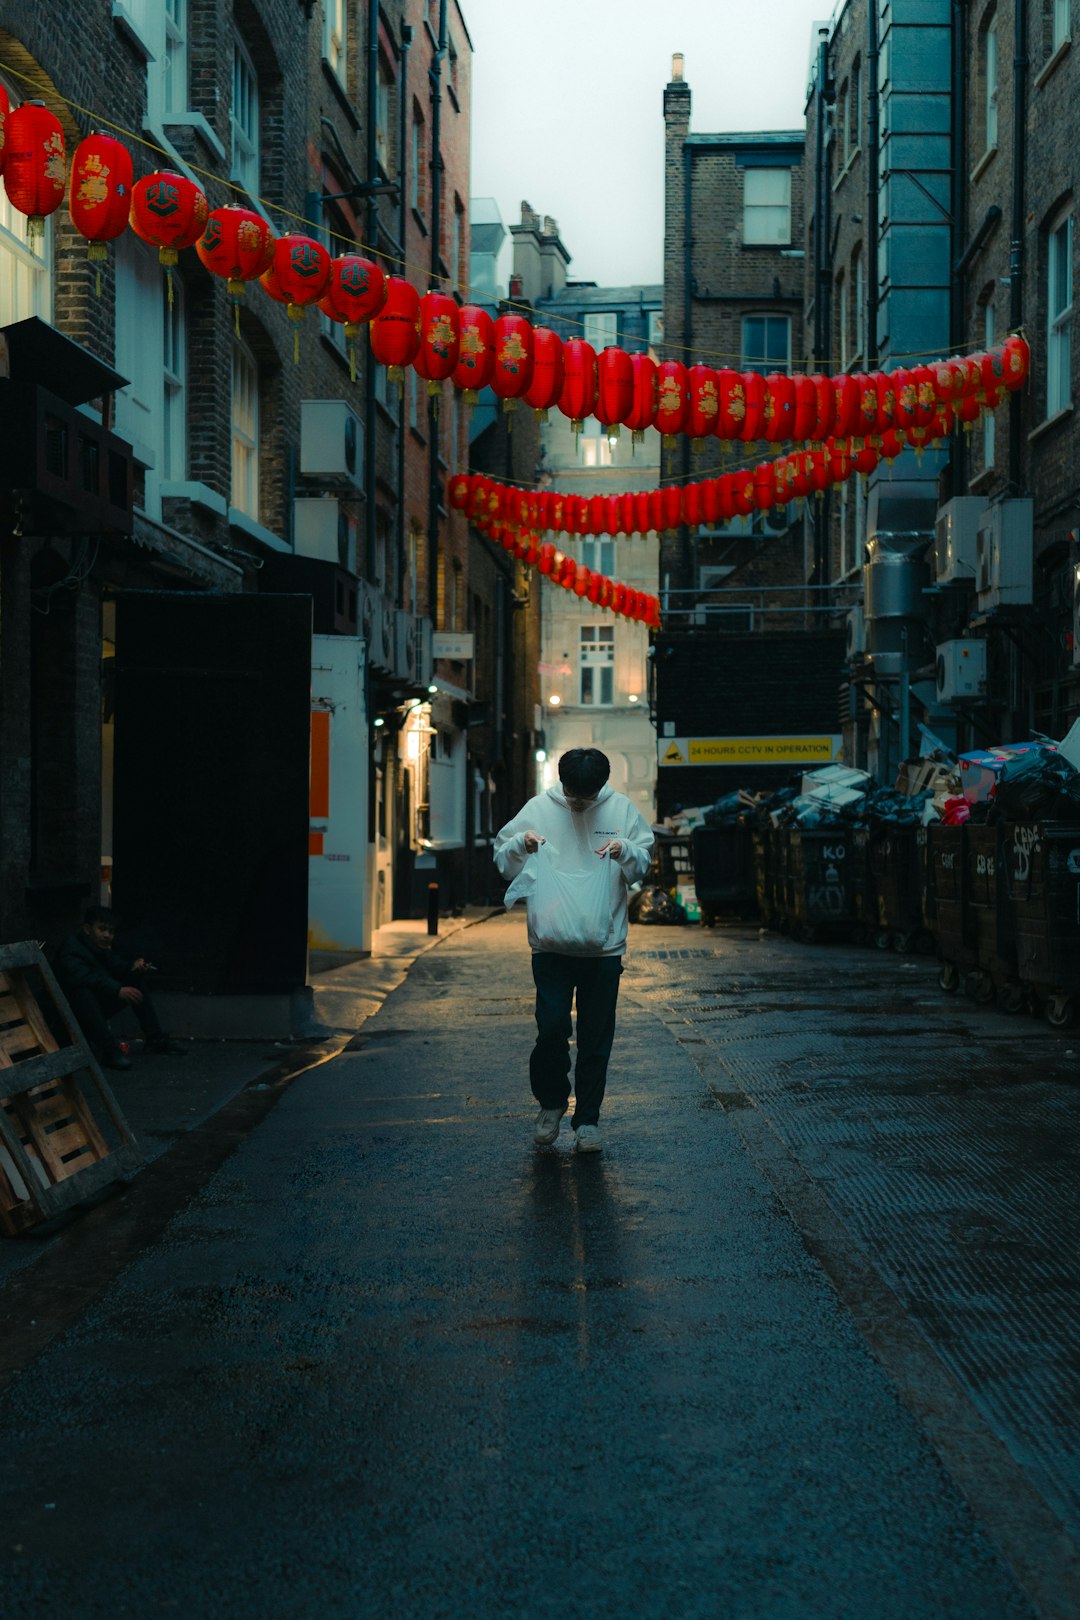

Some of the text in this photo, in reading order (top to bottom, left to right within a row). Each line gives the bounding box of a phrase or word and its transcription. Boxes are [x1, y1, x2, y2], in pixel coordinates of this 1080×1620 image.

[704, 746, 736, 755] HOURS
[738, 745, 762, 754] CCTV
[765, 744, 774, 752] IN
[777, 743, 829, 753] OPERATION
[823, 845, 846, 859] KO
